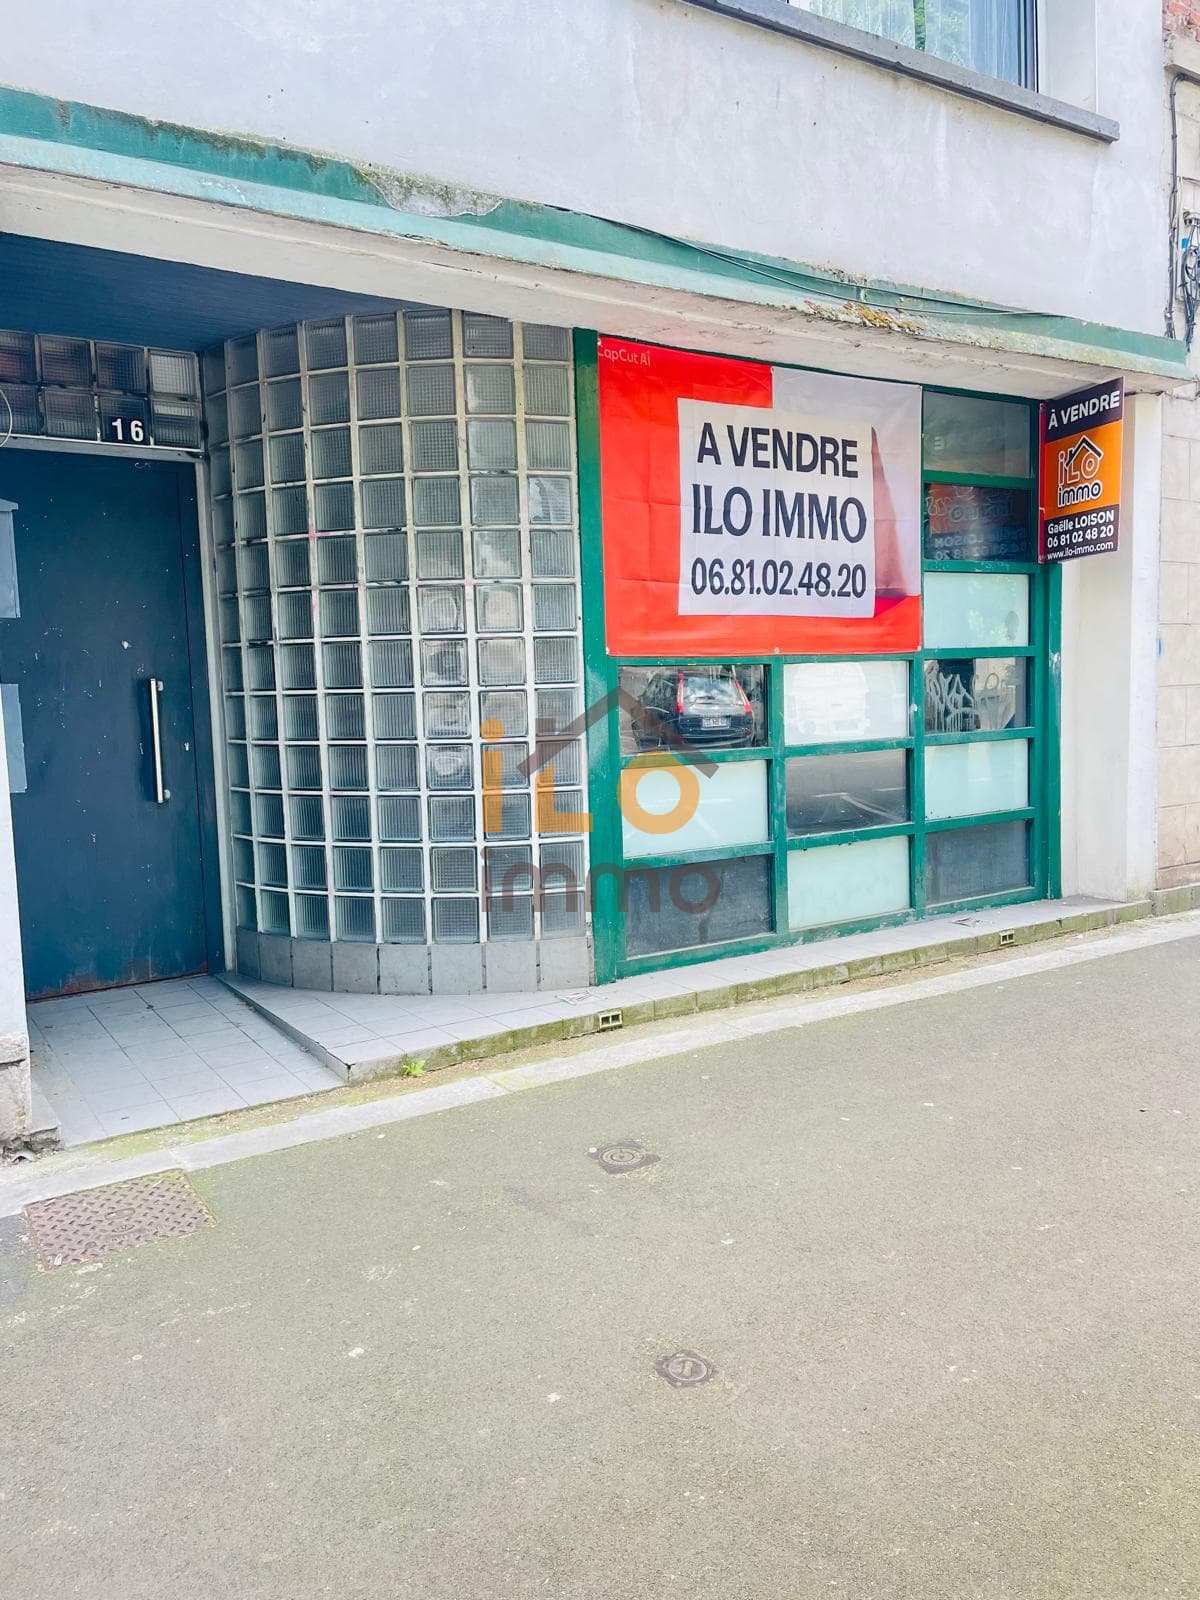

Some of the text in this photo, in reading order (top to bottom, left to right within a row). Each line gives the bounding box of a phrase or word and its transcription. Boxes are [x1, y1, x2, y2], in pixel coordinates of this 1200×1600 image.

[1048, 391, 1120, 430] À VENDRE
[111, 418, 144, 442] 16
[697, 422, 859, 478] A VENDRE
[1057, 479, 1102, 508] immo
[692, 483, 867, 543] ILO IMMO
[1047, 510, 1115, 534] Gaëlle LOISON
[1047, 524, 1114, 548] 06 81 02 48 20
[1047, 541, 1114, 560] www.ilo-immo.com
[691, 557, 867, 599] 06.81.02.48.20
